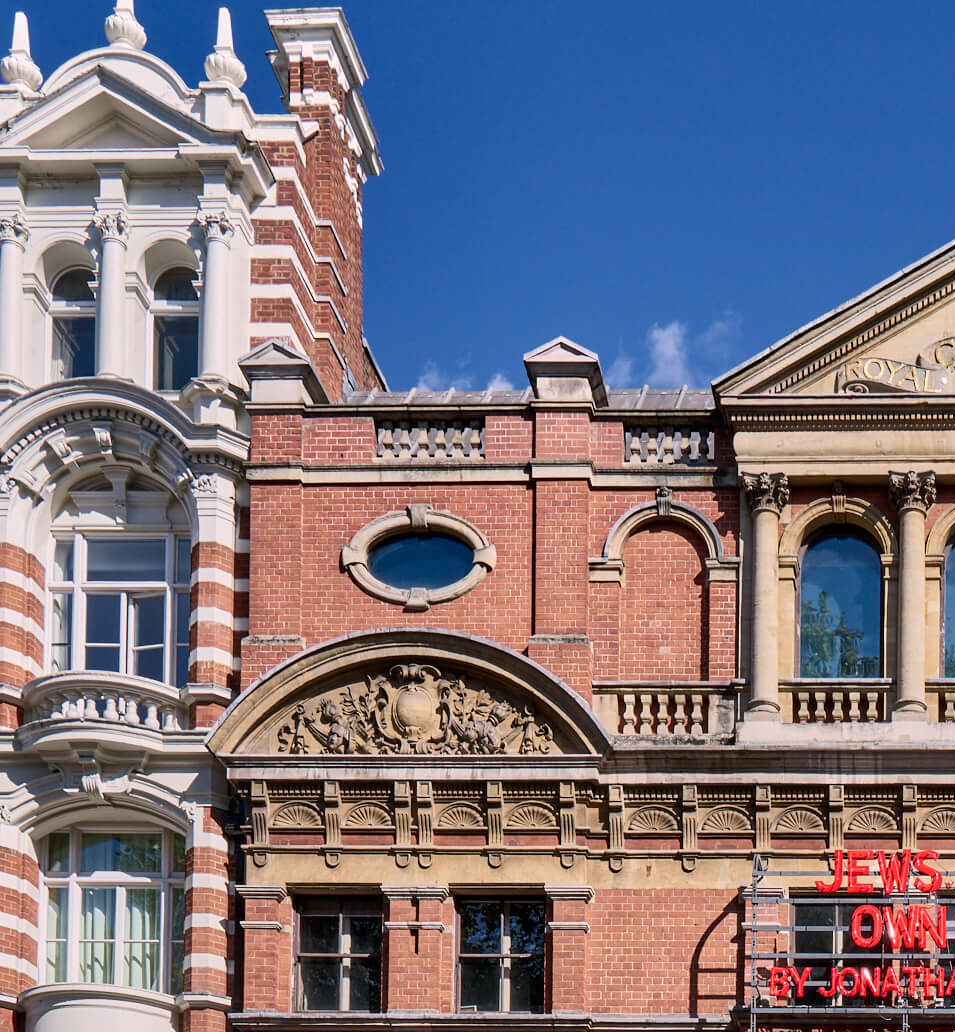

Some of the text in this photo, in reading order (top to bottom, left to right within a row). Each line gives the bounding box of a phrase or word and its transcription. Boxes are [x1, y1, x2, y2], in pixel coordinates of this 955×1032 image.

[843, 357, 942, 393] ROYAL
[851, 904, 947, 949] OWN
[769, 966, 812, 998] BY
